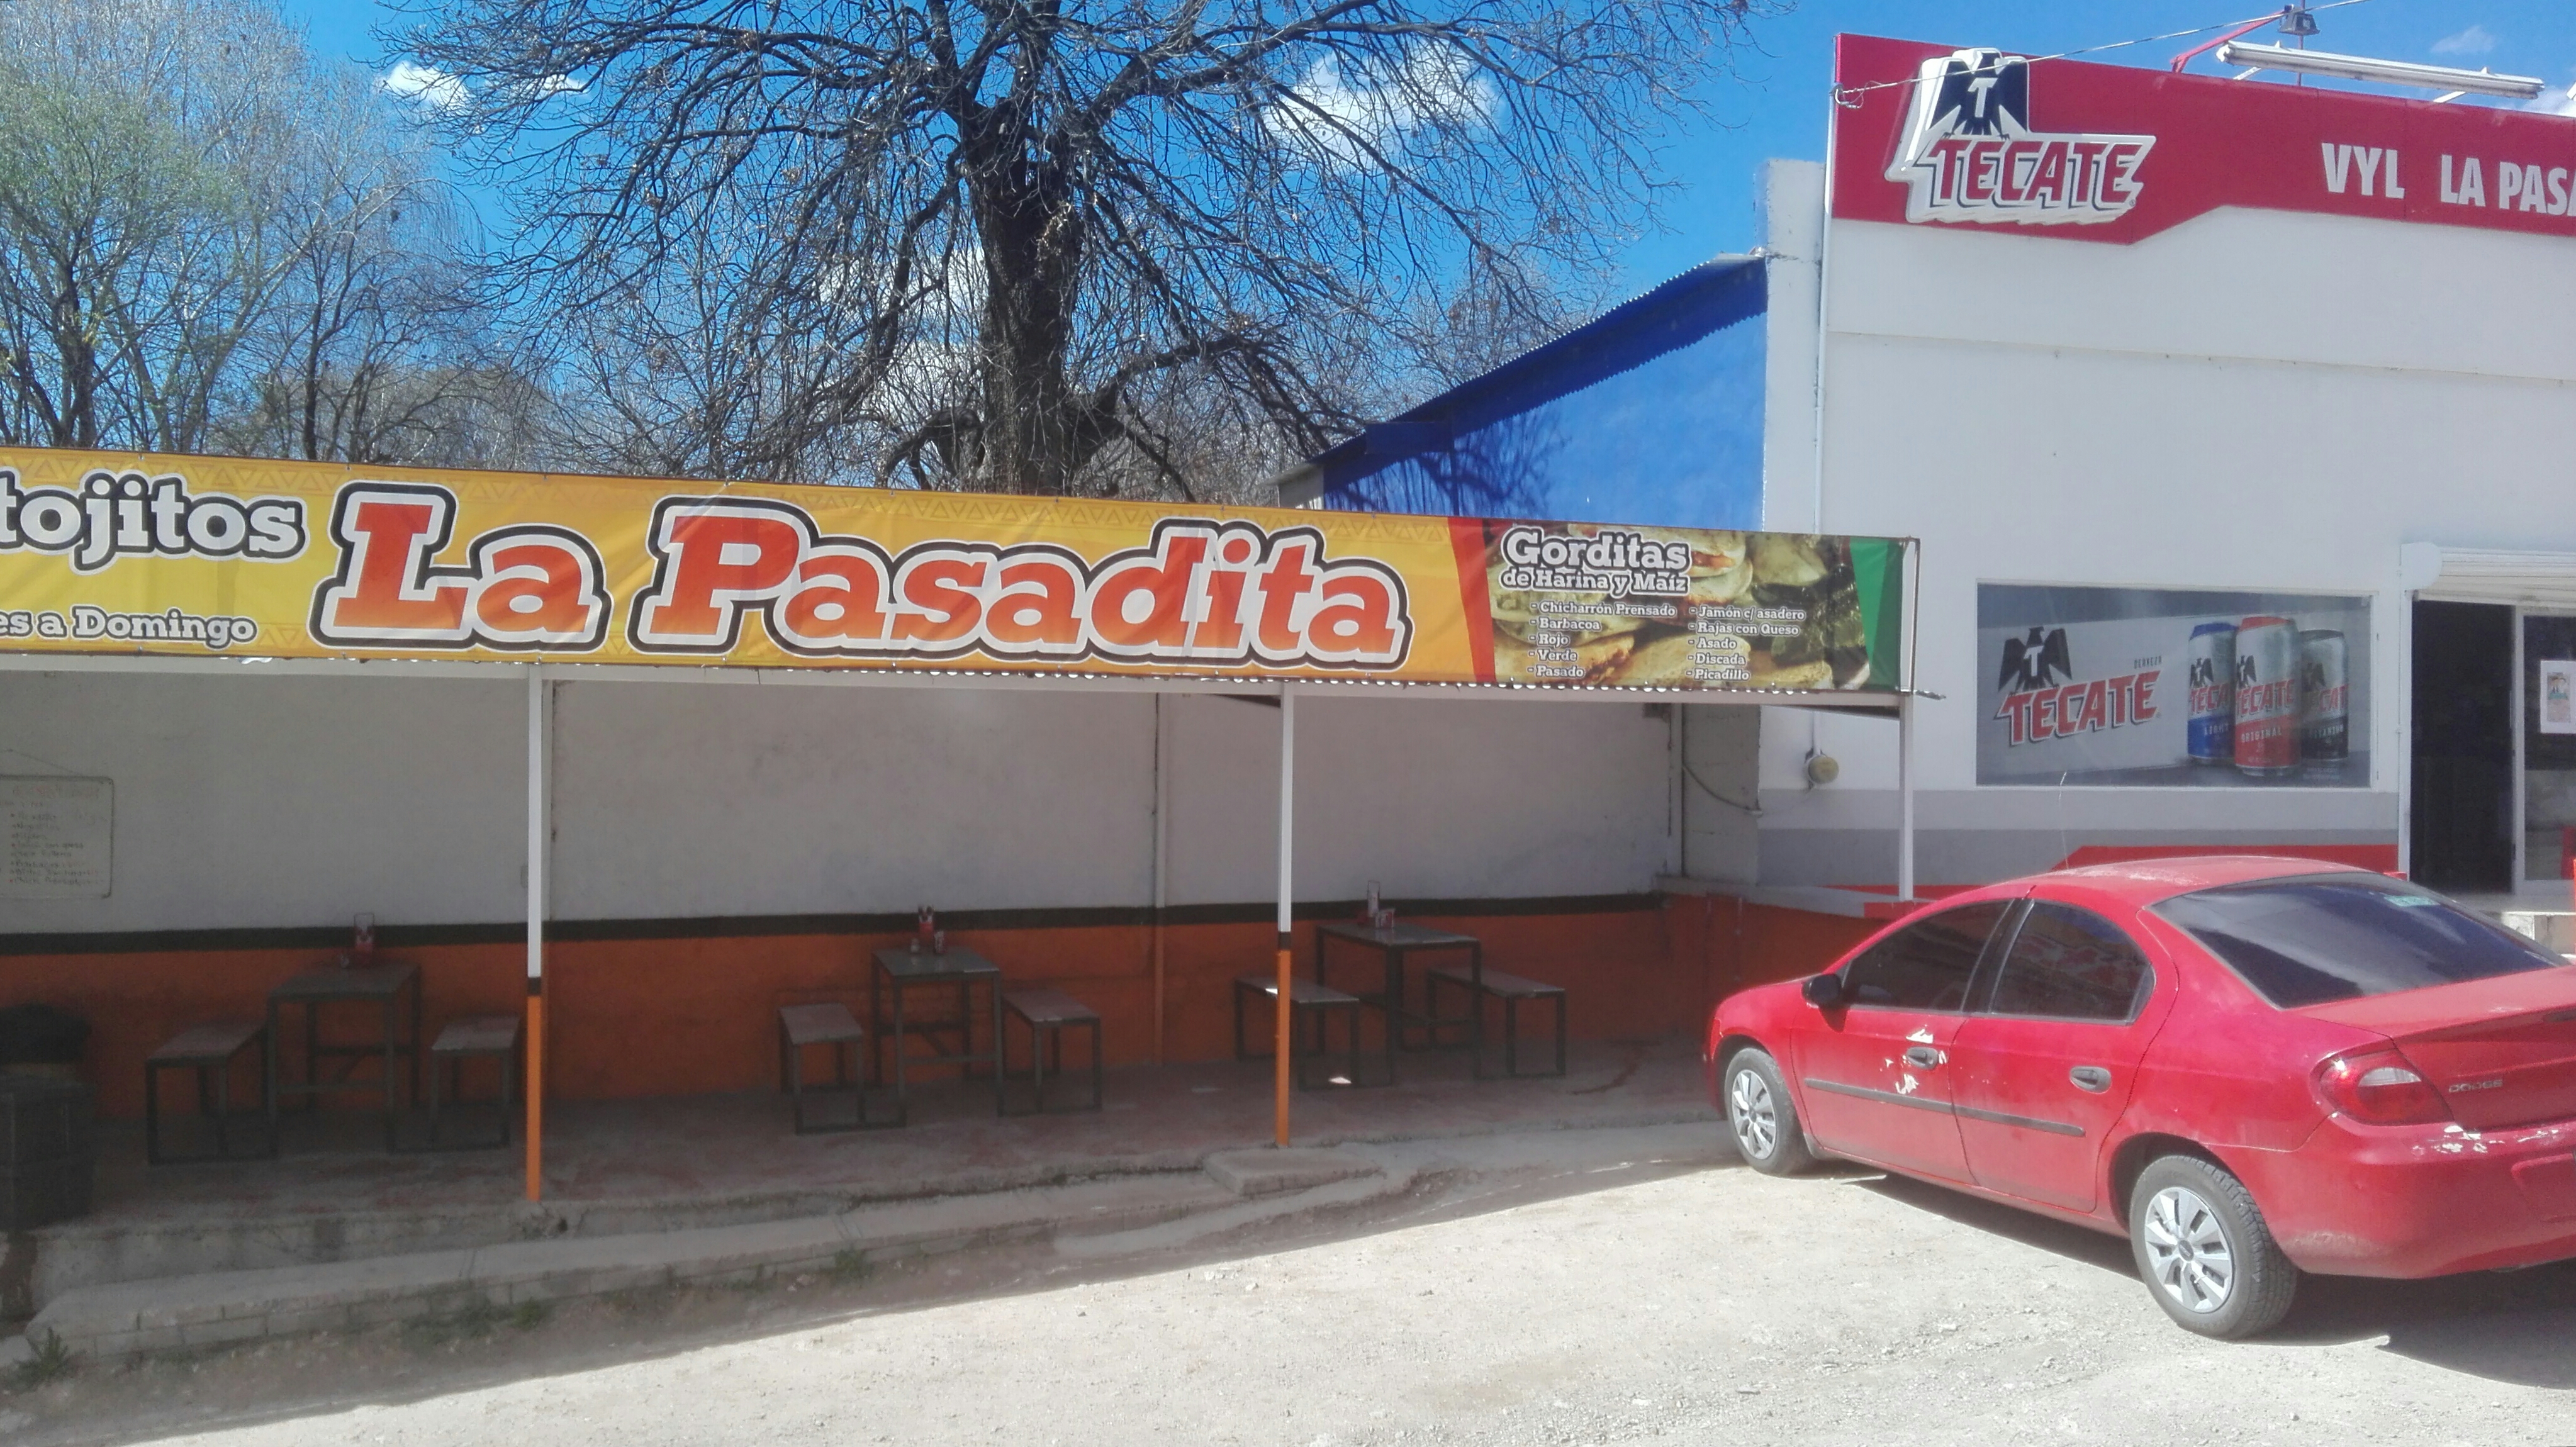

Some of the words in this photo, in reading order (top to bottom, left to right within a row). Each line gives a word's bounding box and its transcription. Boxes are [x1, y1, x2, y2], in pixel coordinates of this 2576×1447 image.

[1920, 138, 2143, 206] TECATE
[2321, 142, 2405, 199] VYL
[2441, 154, 2486, 207] LA
[1505, 530, 1688, 569] Gorditas
[322, 492, 599, 640] La
[641, 505, 1403, 661] Pasadita
[1502, 568, 1531, 588] de
[1535, 569, 1610, 590] Harina
[1611, 574, 1628, 594] y
[1540, 602, 1612, 615] Chicharrón
[1615, 603, 1676, 617] Prensado
[1699, 606, 1741, 619] Jamón
[1757, 609, 1806, 620] asadero
[38, 613, 65, 636] a
[74, 607, 255, 647] Domingo
[1538, 617, 1600, 630] Barbacoa
[1698, 622, 1732, 635] Rajas
[1734, 625, 1758, 635] con
[1761, 624, 1800, 636] Queso
[1538, 634, 1569, 648] Rojo
[1696, 638, 1737, 650] Asado
[1537, 649, 1577, 662] Verde
[1694, 653, 1745, 666] Discada
[1535, 666, 1584, 678] Pasado
[1694, 668, 1750, 681] Picadillo
[1996, 670, 2161, 745] TECATE
[2241, 726, 2282, 742] ORIGINAL
[2448, 1079, 2503, 1093] DODGE
